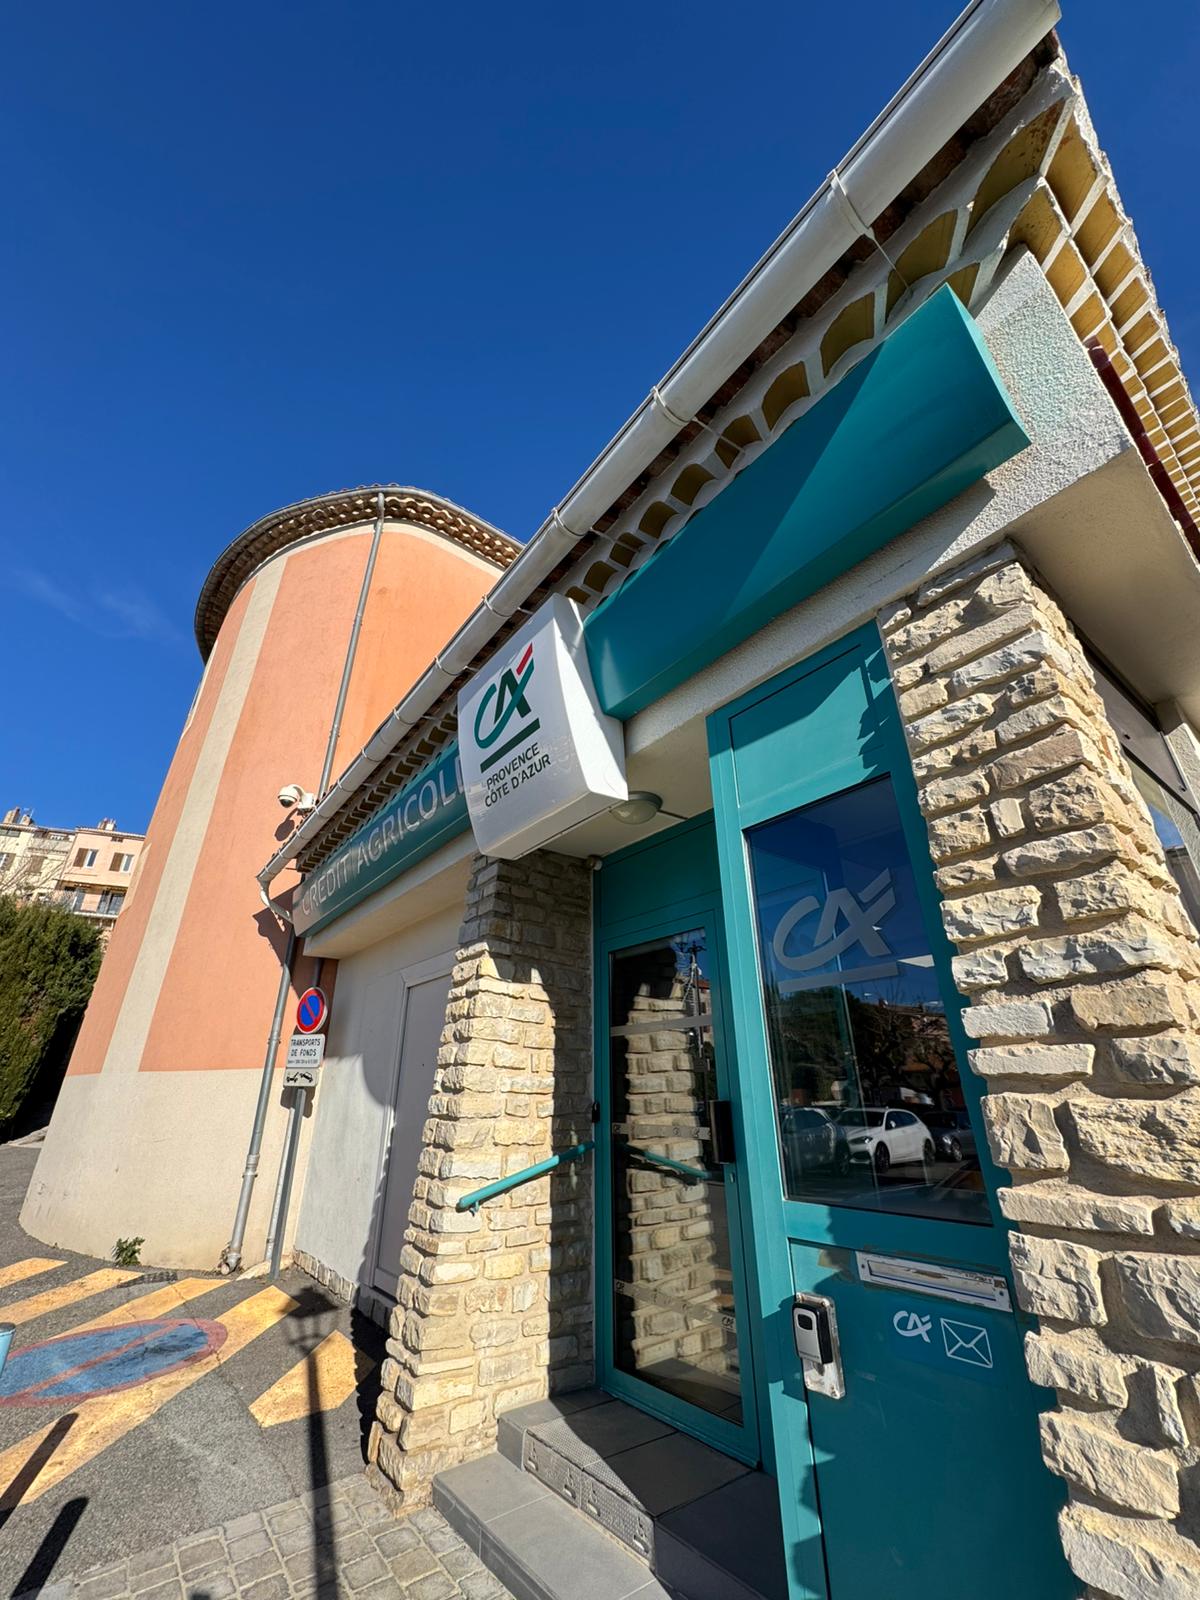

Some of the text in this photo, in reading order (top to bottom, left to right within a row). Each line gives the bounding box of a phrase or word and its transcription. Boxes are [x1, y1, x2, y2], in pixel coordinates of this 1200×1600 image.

[484, 753, 551, 808] CÔTE D'AZUR
[486, 742, 540, 790] PROVENCE
